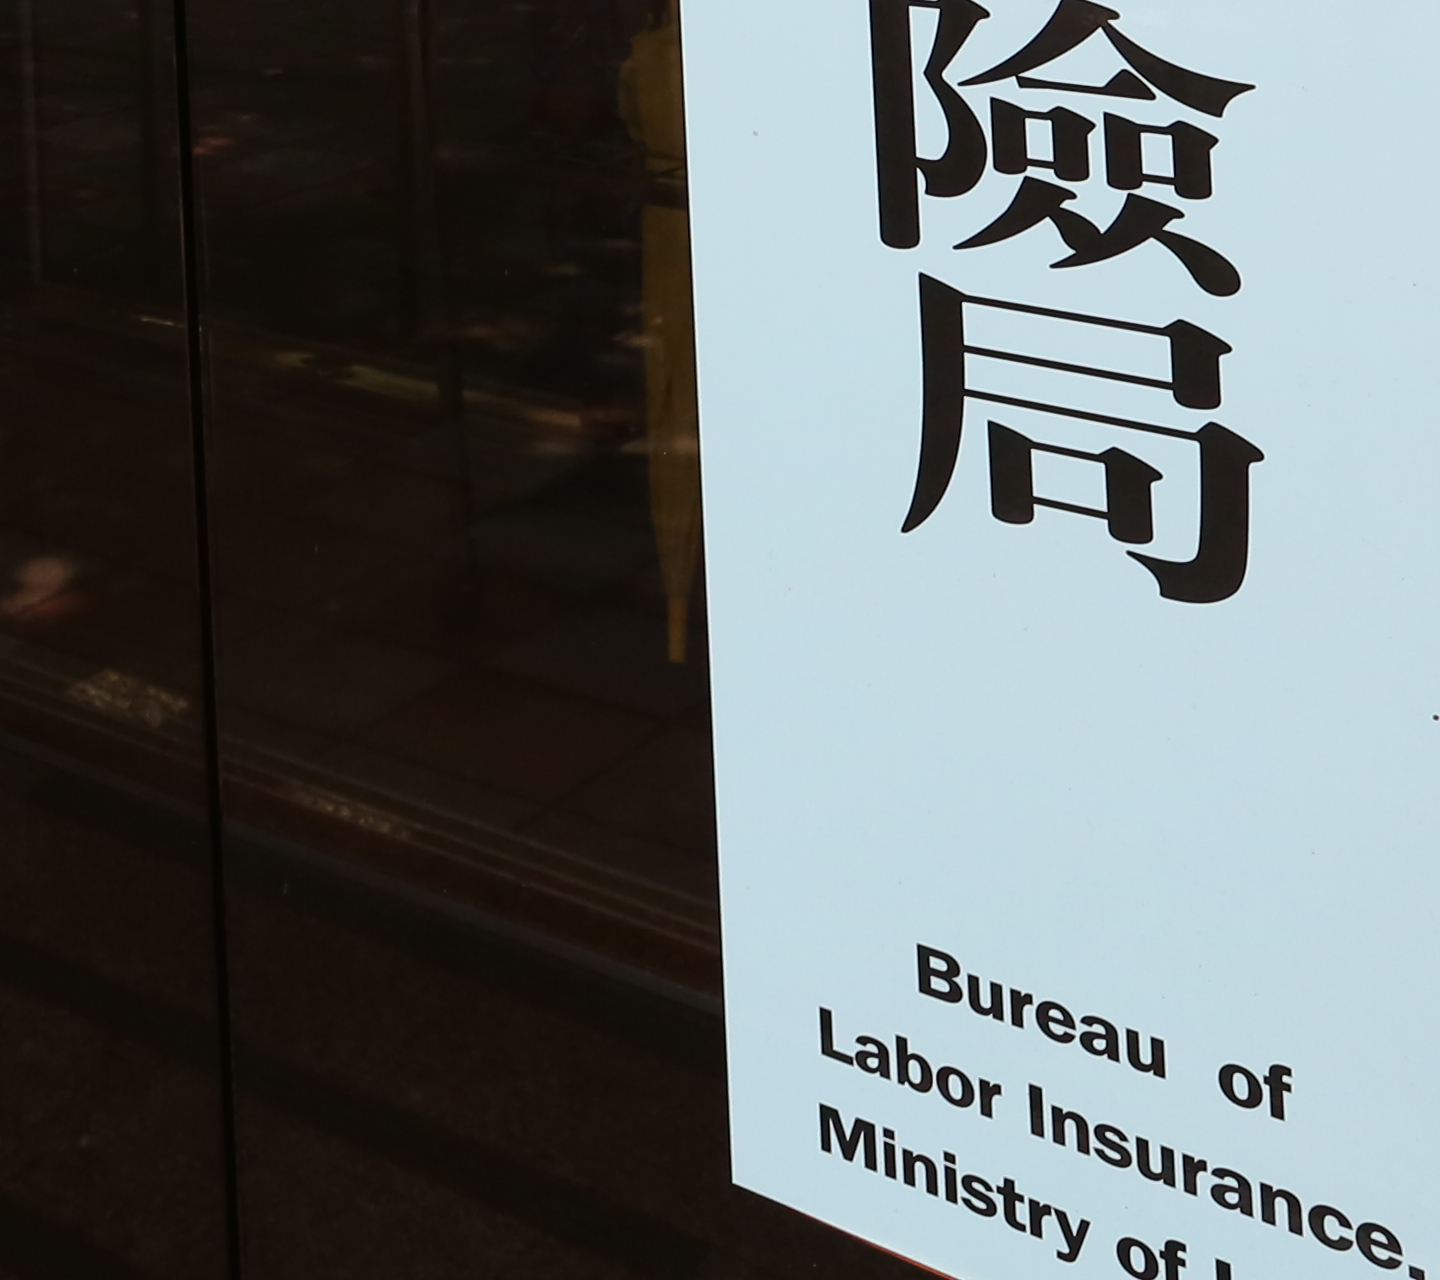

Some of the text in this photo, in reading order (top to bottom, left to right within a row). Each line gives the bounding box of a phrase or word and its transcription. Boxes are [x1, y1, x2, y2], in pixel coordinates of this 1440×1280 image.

[818, 1006, 1002, 1119] Labor
[916, 942, 1293, 1122] Bureau of
[818, 1102, 1187, 1280] Ministry of
